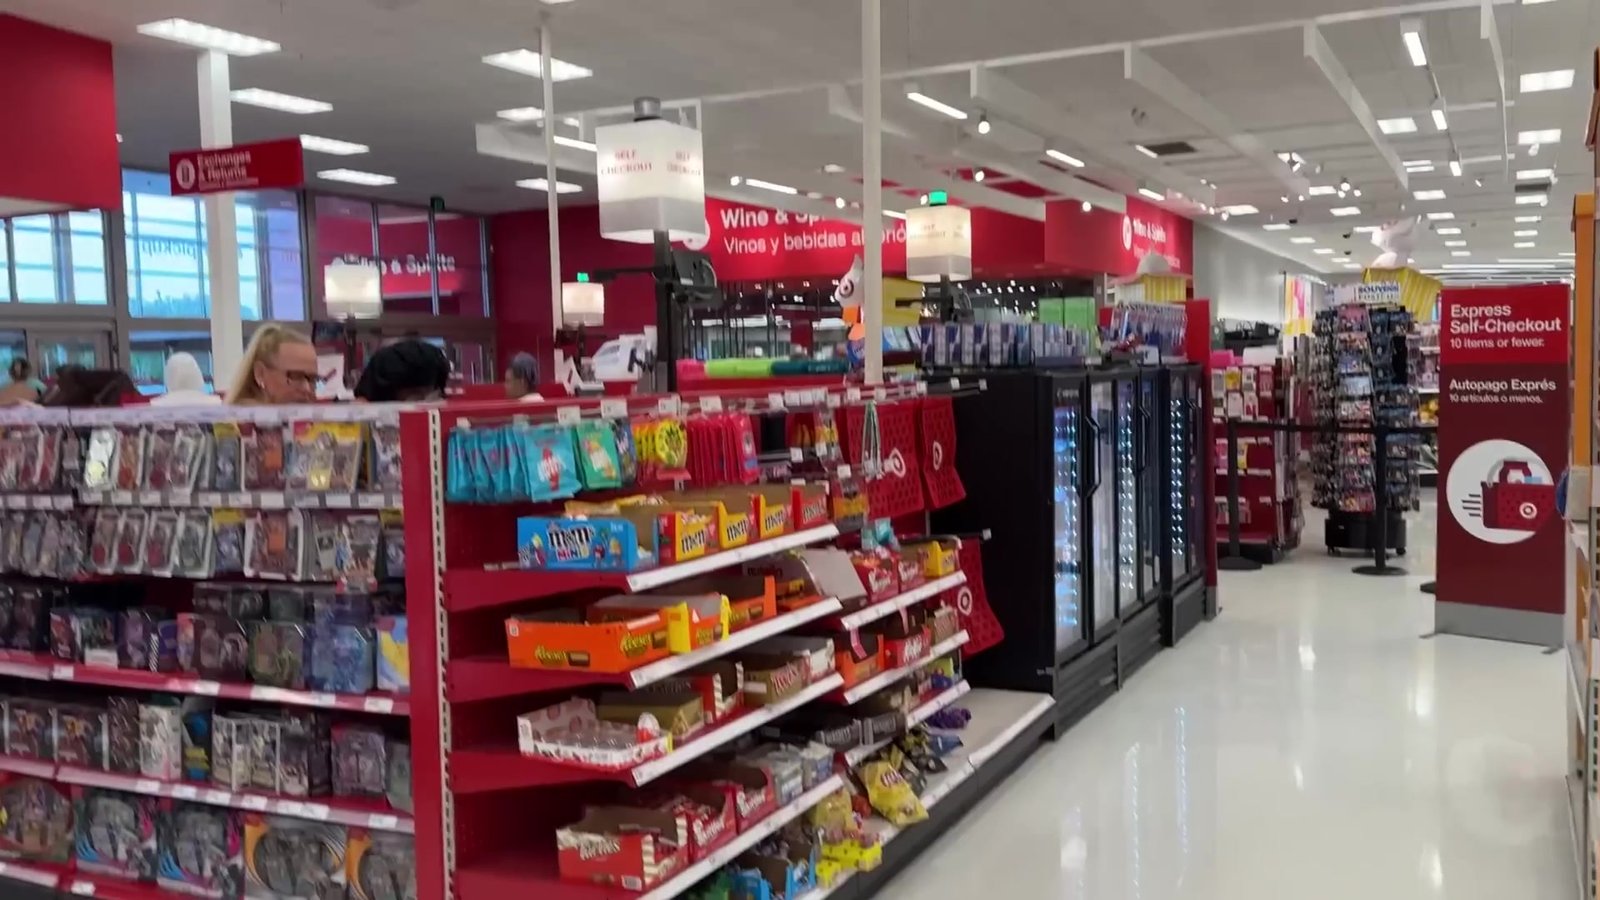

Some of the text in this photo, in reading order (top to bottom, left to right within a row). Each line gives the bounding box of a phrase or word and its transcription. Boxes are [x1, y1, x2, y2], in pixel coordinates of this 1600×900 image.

[720, 208, 769, 229] Wine
[774, 208, 789, 225] &
[723, 236, 767, 255] Vinos
[770, 236, 779, 256] y
[783, 229, 847, 251] bebidas
[1450, 303, 1512, 319] Express
[1450, 317, 1562, 335] Self-Checkout
[1450, 337, 1461, 349] 10
[1464, 337, 1495, 348] items
[1497, 338, 1509, 348] or
[1449, 377, 1557, 393] Autopago Exprés
[1449, 393, 1459, 403] 10
[1500, 395, 1508, 403] o
